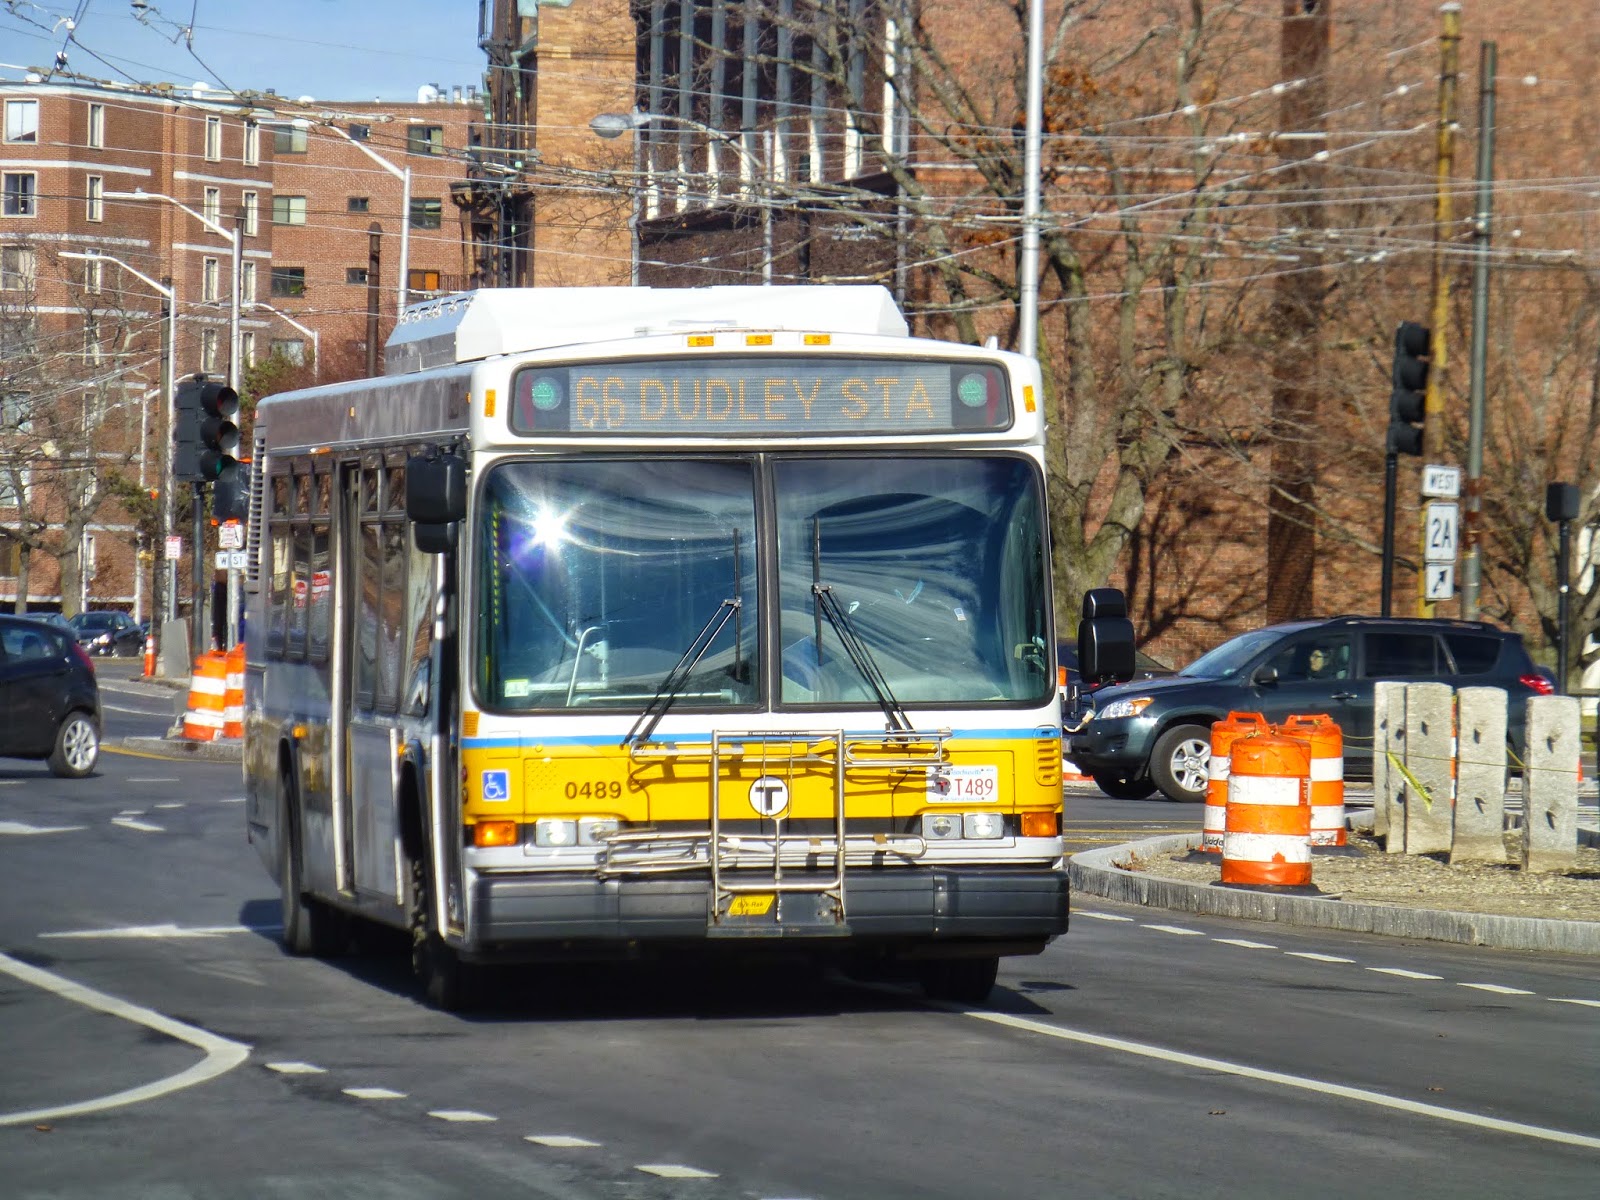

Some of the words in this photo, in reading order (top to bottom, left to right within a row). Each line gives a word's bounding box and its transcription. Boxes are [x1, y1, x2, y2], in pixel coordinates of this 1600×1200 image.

[576, 377, 625, 427] 66
[640, 379, 822, 420] DUDLEY
[841, 378, 935, 419] STA
[1430, 474, 1455, 490] WEST
[1431, 518, 1452, 548] 2A
[221, 556, 243, 566] WST
[564, 781, 622, 800] 0489
[954, 778, 994, 796] T489
[755, 786, 783, 811] T
